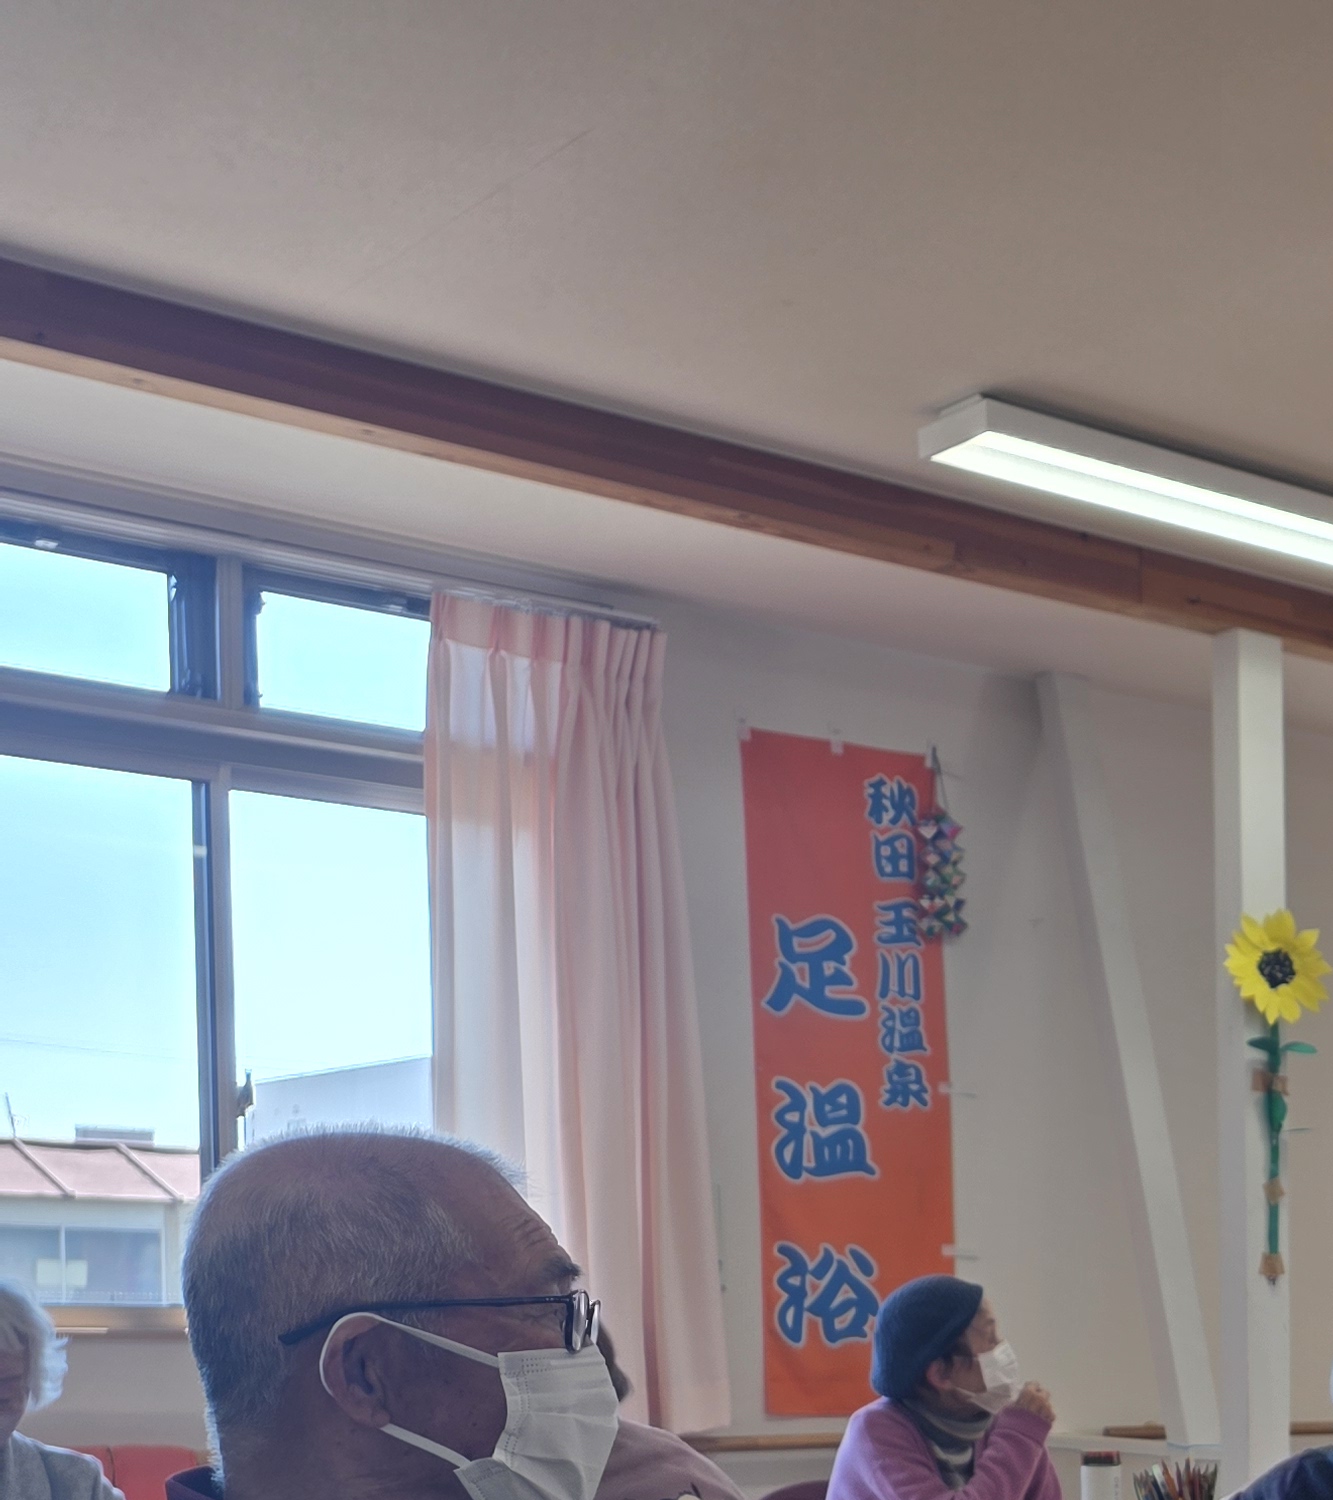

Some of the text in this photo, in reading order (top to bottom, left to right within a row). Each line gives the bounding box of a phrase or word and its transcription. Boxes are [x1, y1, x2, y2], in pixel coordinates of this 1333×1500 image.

[761, 912, 881, 1346] 足温浴
[863, 773, 930, 1109] 秋田 玉川温泉
